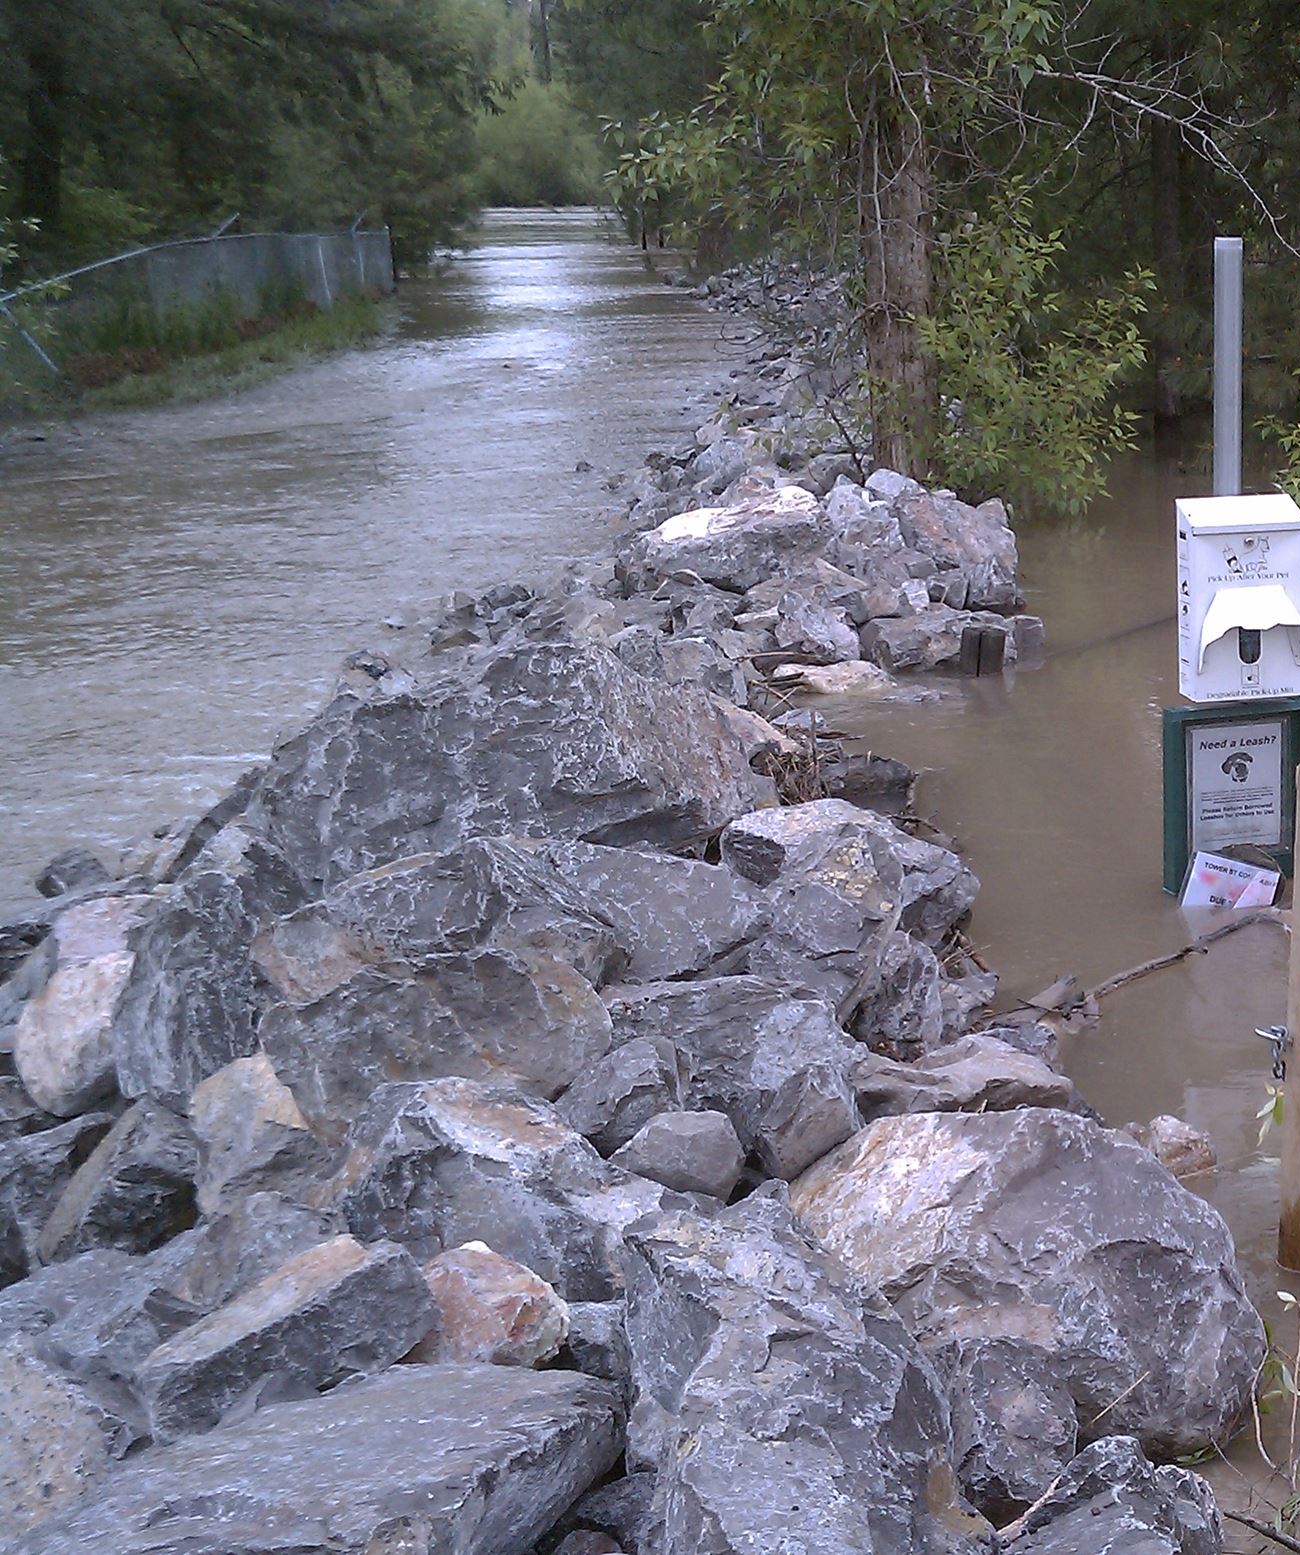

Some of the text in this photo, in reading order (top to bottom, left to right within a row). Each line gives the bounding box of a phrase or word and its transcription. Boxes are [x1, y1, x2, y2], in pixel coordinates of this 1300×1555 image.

[1200, 735, 1277, 750] Need a Leash?
[1204, 862, 1229, 874] TOWER
